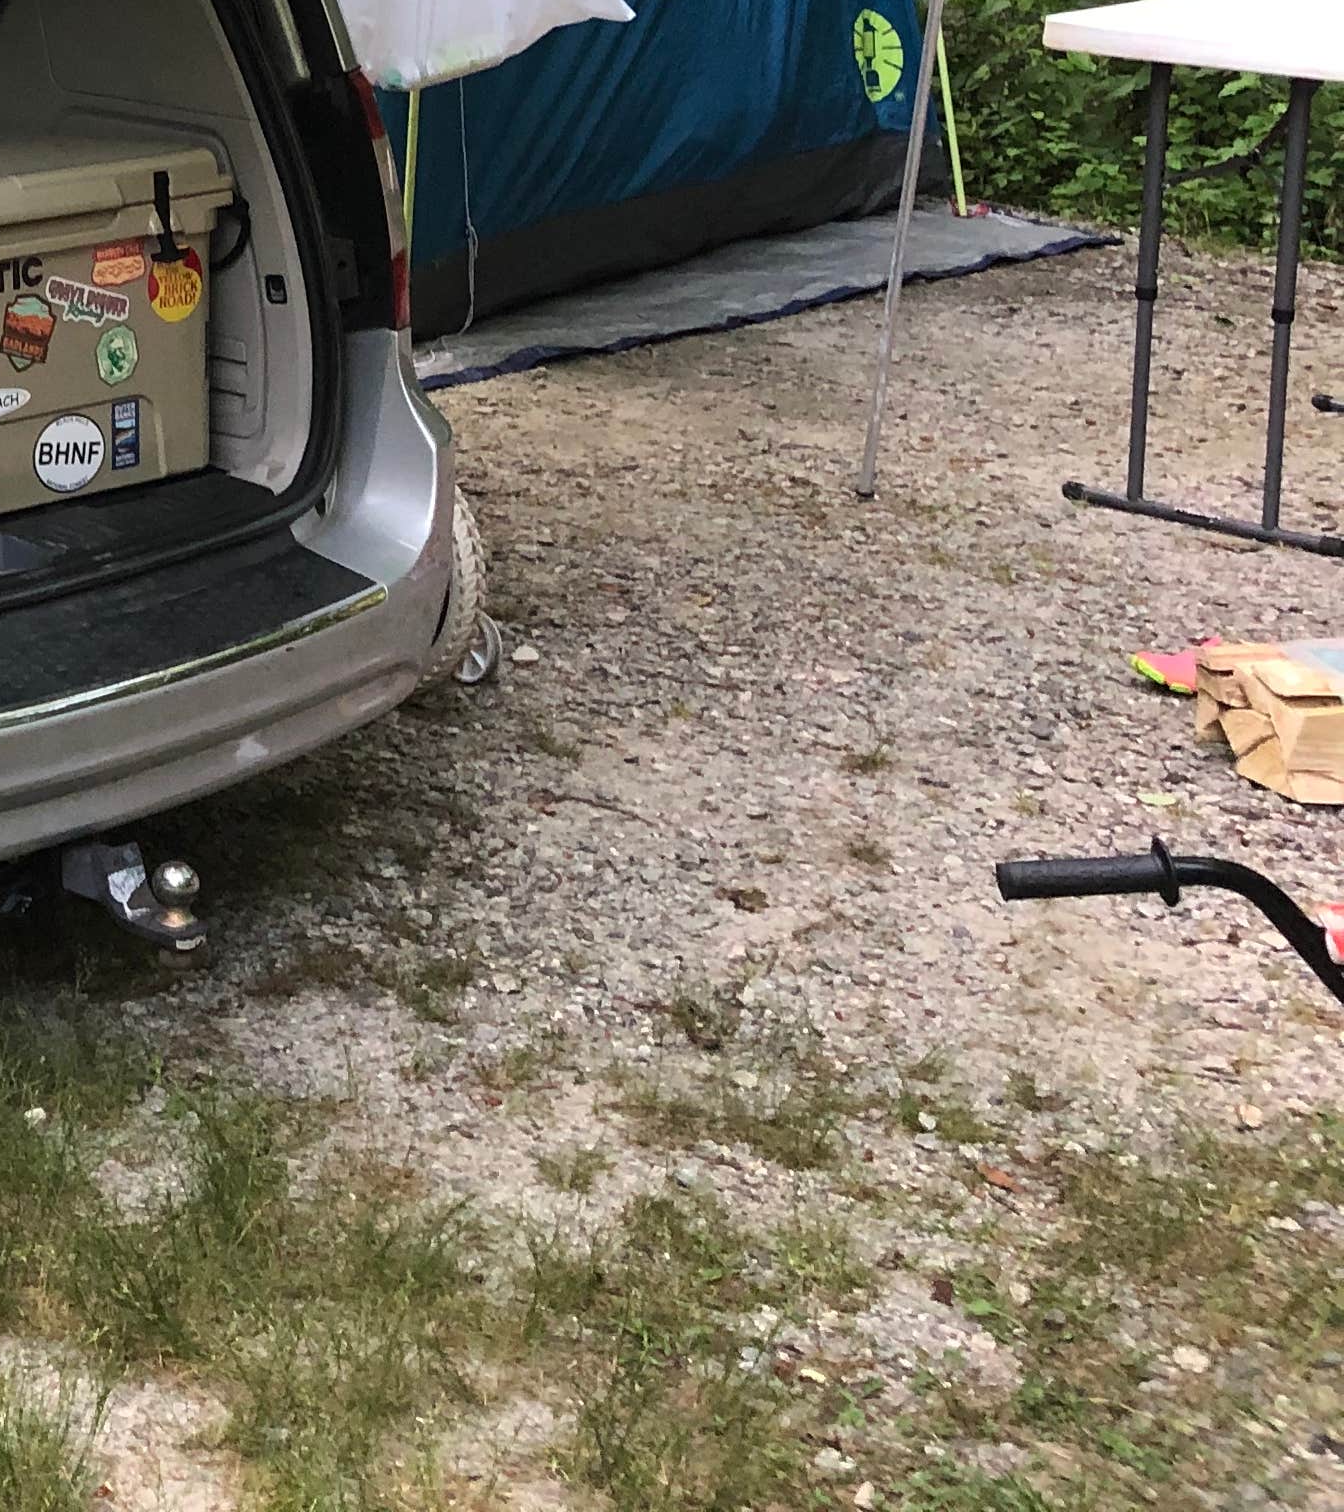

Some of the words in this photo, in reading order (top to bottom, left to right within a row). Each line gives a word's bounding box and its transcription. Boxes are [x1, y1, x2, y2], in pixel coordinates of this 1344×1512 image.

[164, 280, 198, 295] BRICK
[159, 292, 196, 309] ROAD!
[38, 441, 101, 465] BHNF
